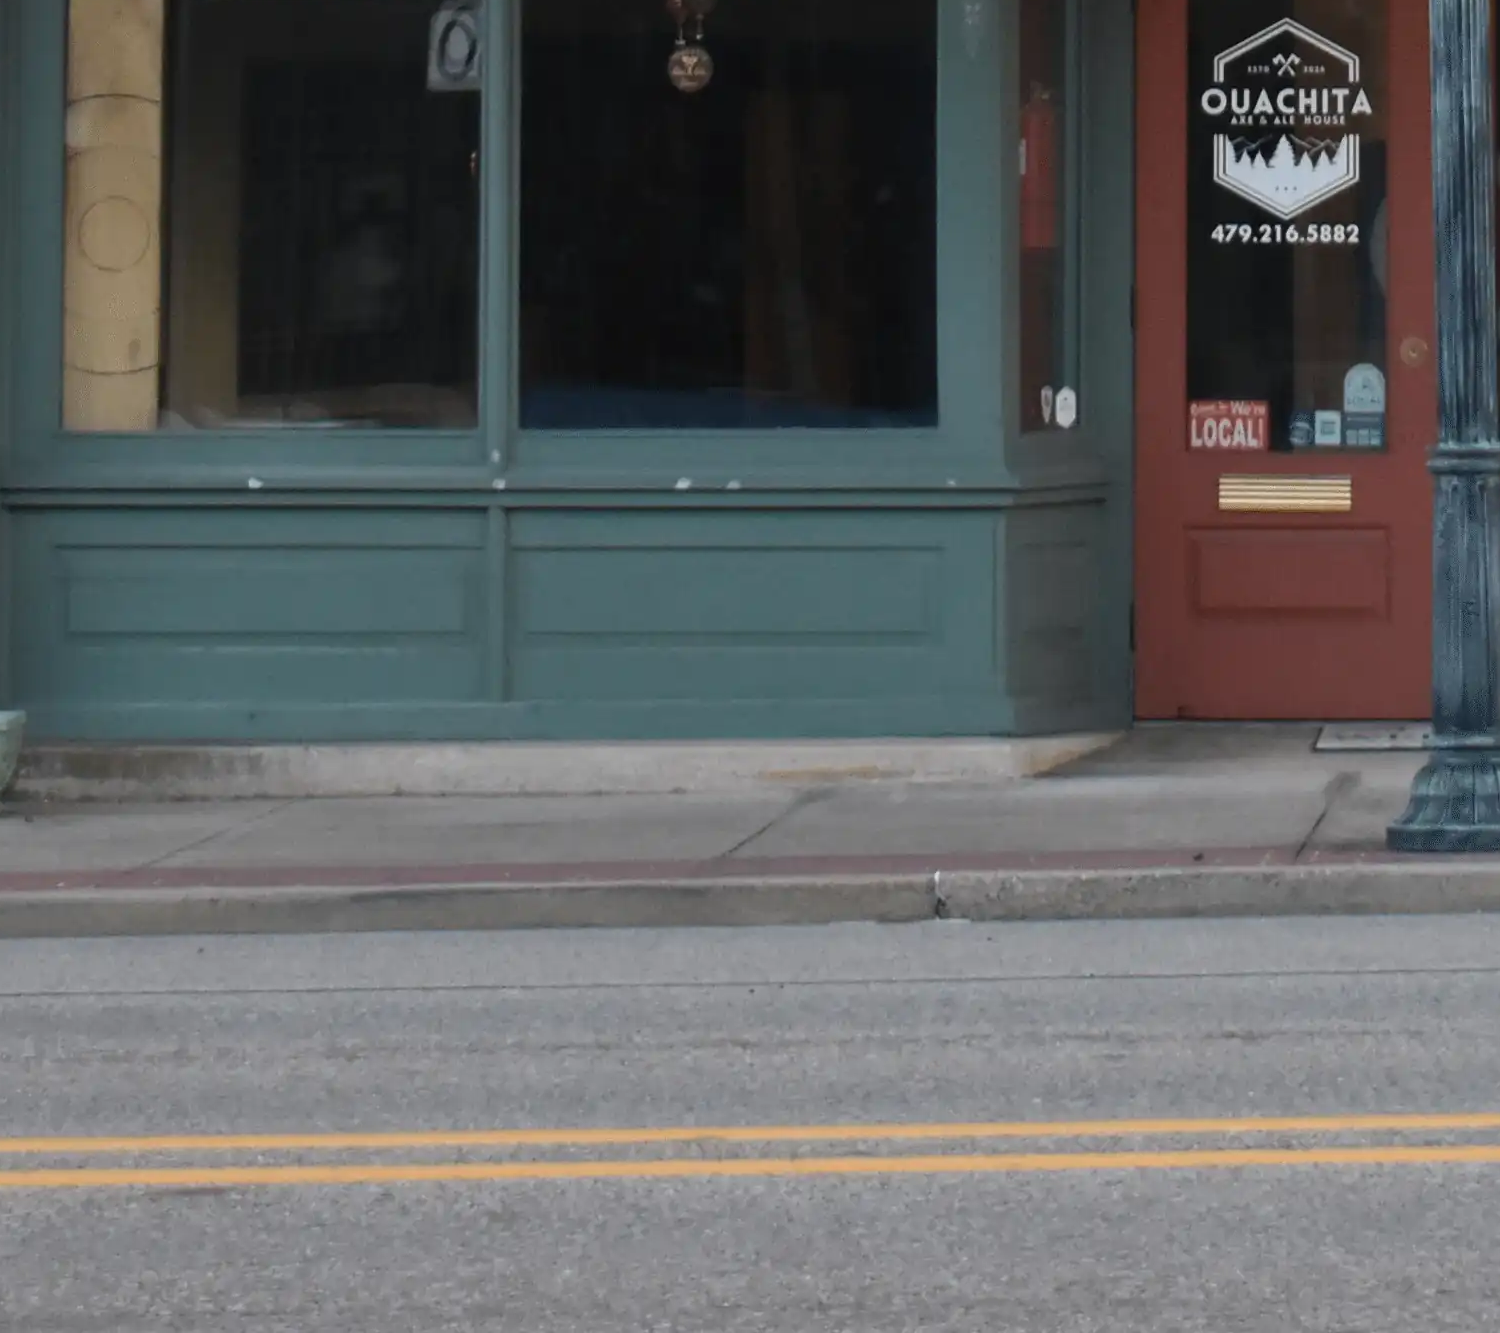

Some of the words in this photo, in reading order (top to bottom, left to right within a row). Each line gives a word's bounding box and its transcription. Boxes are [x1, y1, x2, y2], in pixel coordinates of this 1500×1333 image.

[1201, 88, 1373, 116] OUACHITA
[1230, 115, 1254, 126] AXE
[1273, 115, 1296, 126] ALE
[1303, 115, 1346, 126] HOUSE
[1211, 223, 1360, 244] 479.216.5882
[1190, 417, 1264, 448] LOCAL!
